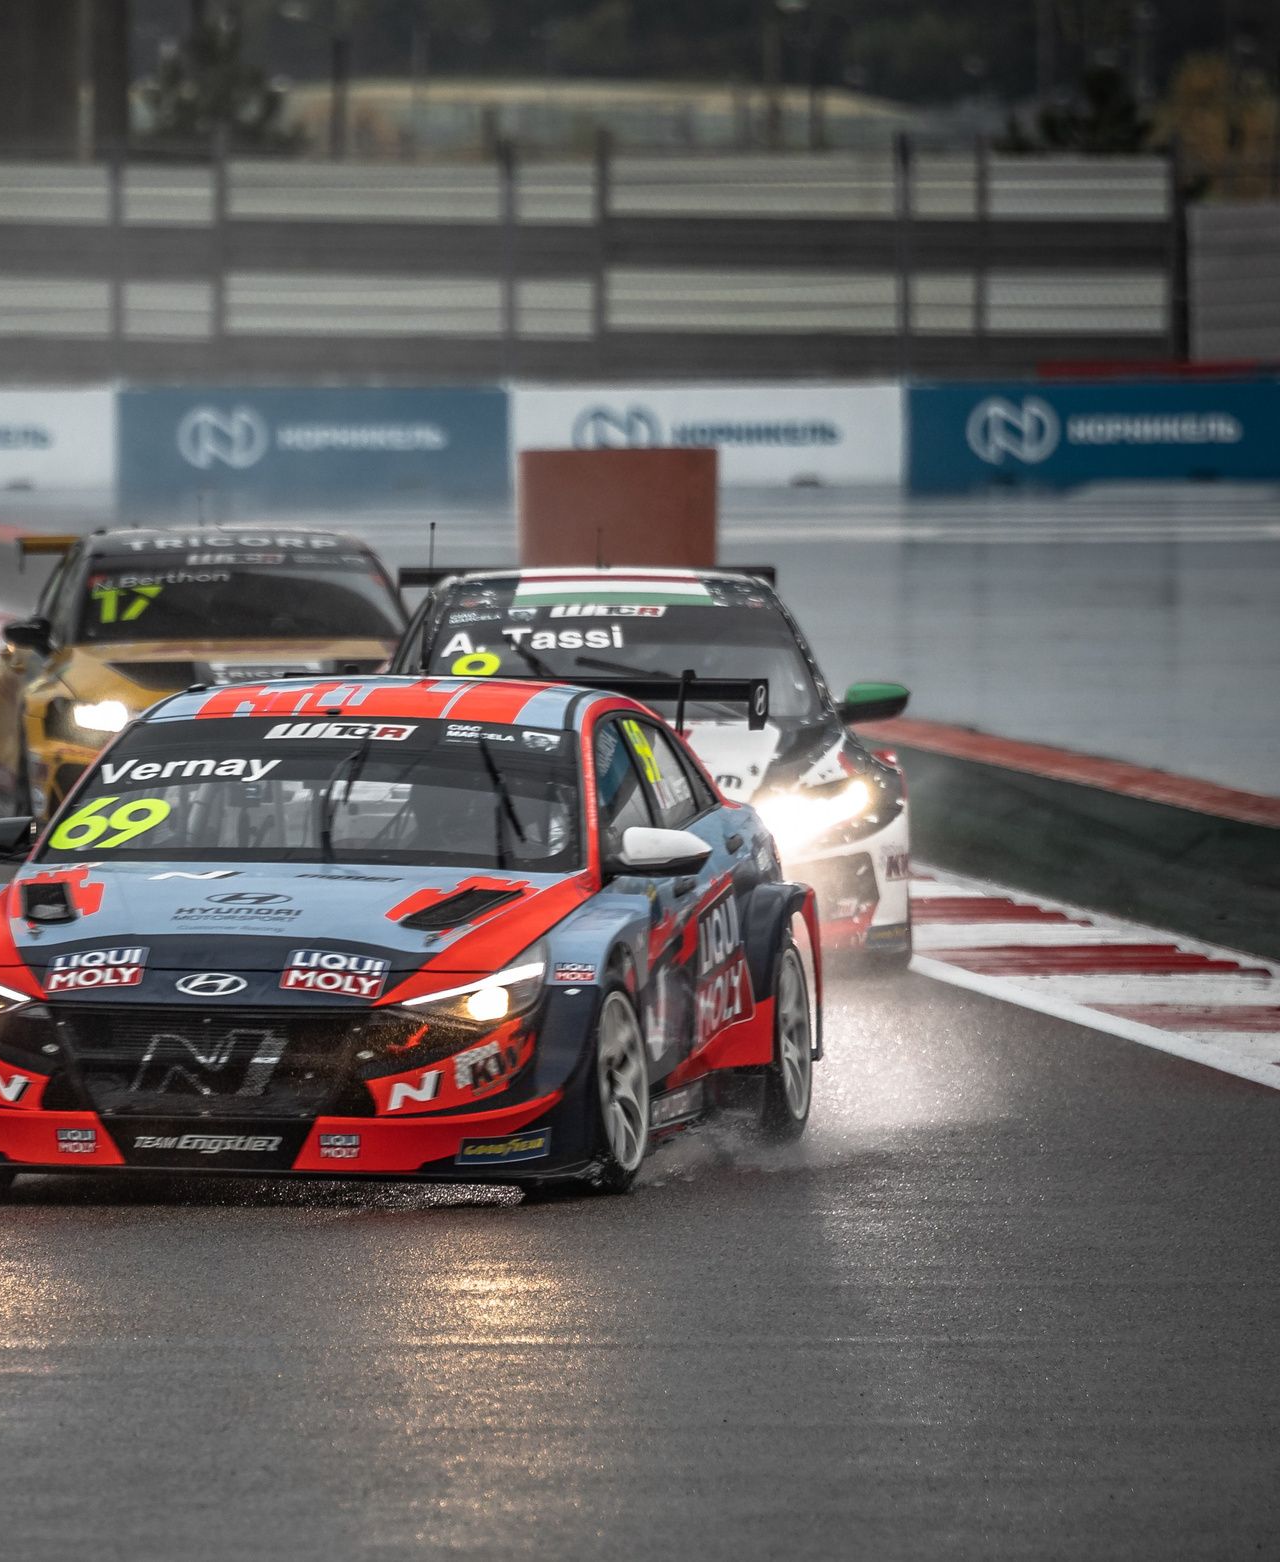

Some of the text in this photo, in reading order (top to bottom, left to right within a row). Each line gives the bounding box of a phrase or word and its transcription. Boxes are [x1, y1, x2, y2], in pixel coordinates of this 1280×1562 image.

[123, 537, 338, 551] TRICORP
[121, 570, 231, 588] Berthon
[93, 587, 164, 624] 17
[441, 624, 624, 658] A. Tassi
[101, 758, 282, 785] Vernay
[48, 797, 171, 850] 69
[170, 915, 299, 923] MOTORSPORT
[174, 907, 304, 916] HYUNDAI
[53, 949, 143, 971] LIQUI
[291, 951, 385, 977] LIQUI
[48, 967, 140, 990] MOLY
[286, 970, 382, 995] MOLY
[133, 1136, 179, 1149] TEAM
